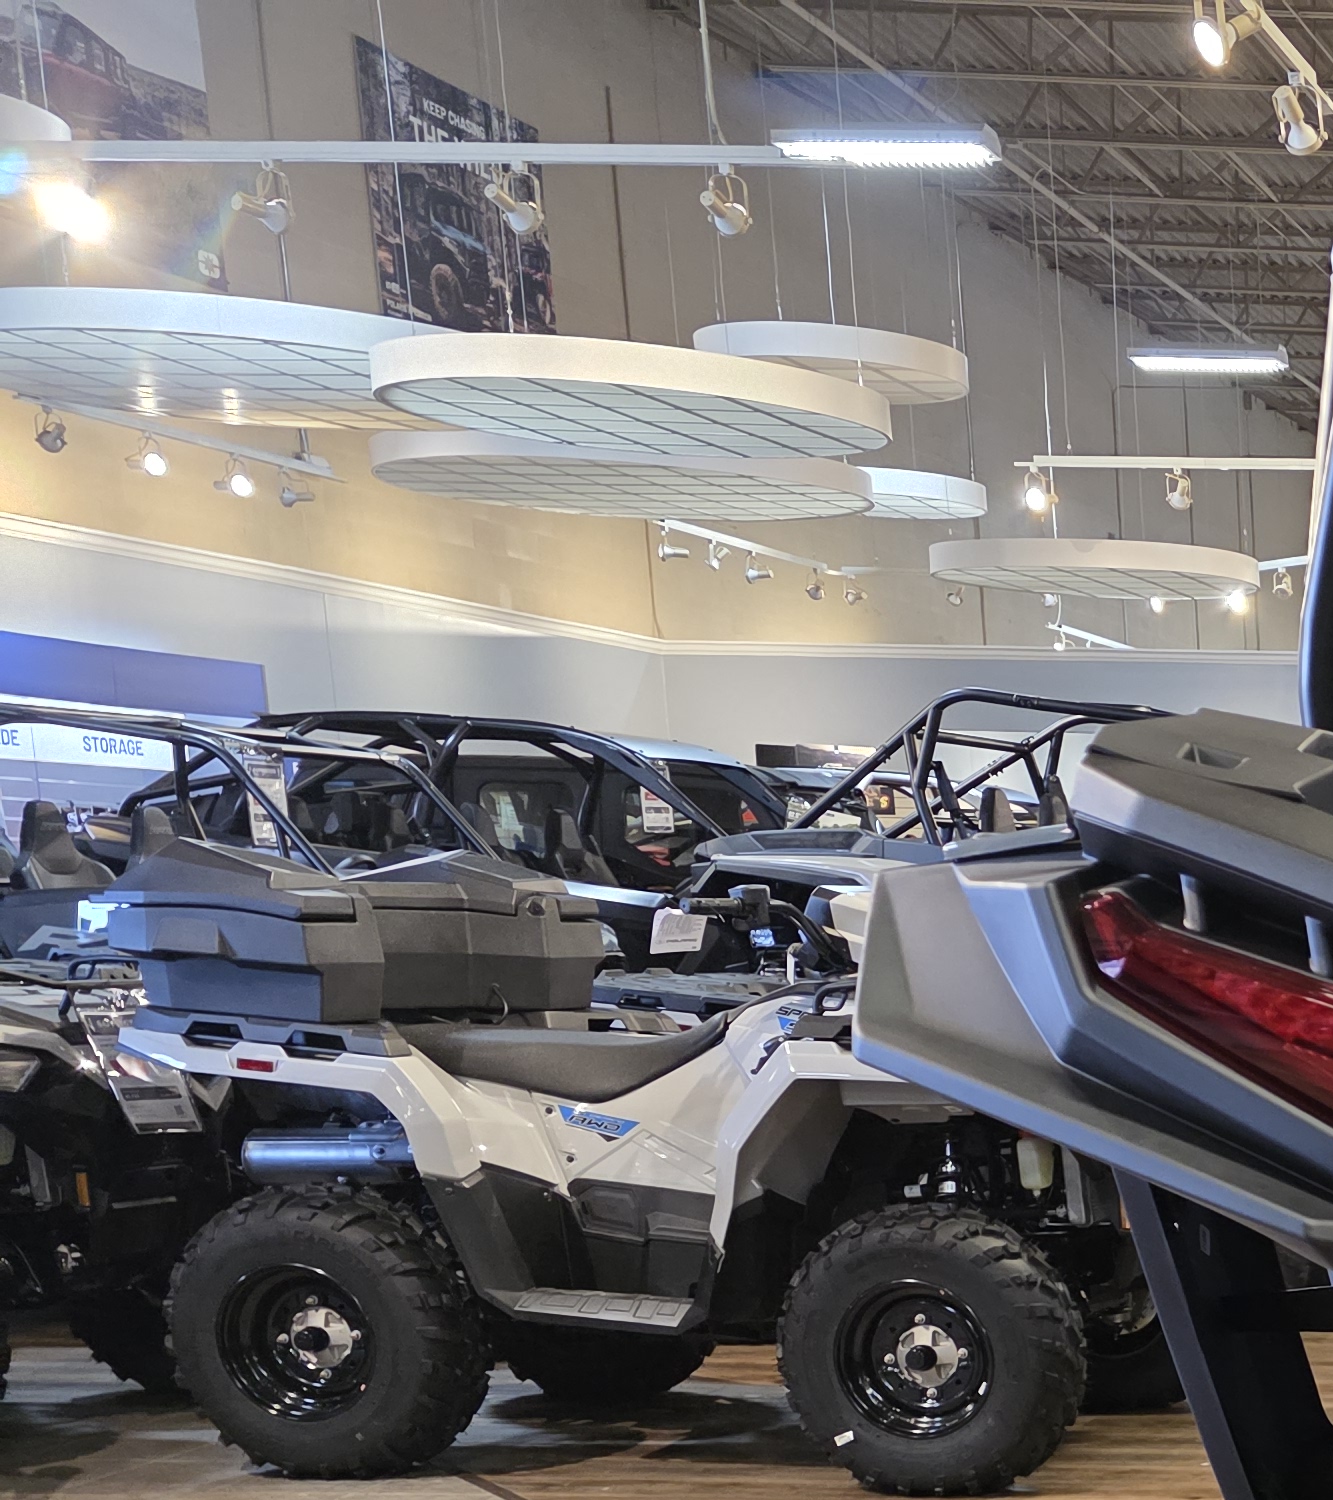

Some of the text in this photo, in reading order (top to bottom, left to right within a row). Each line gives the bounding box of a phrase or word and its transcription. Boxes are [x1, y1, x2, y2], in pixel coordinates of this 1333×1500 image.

[422, 98, 486, 141] KEEP CHASING
[83, 735, 144, 757] STORAGE
[568, 1114, 621, 1132] AWD
